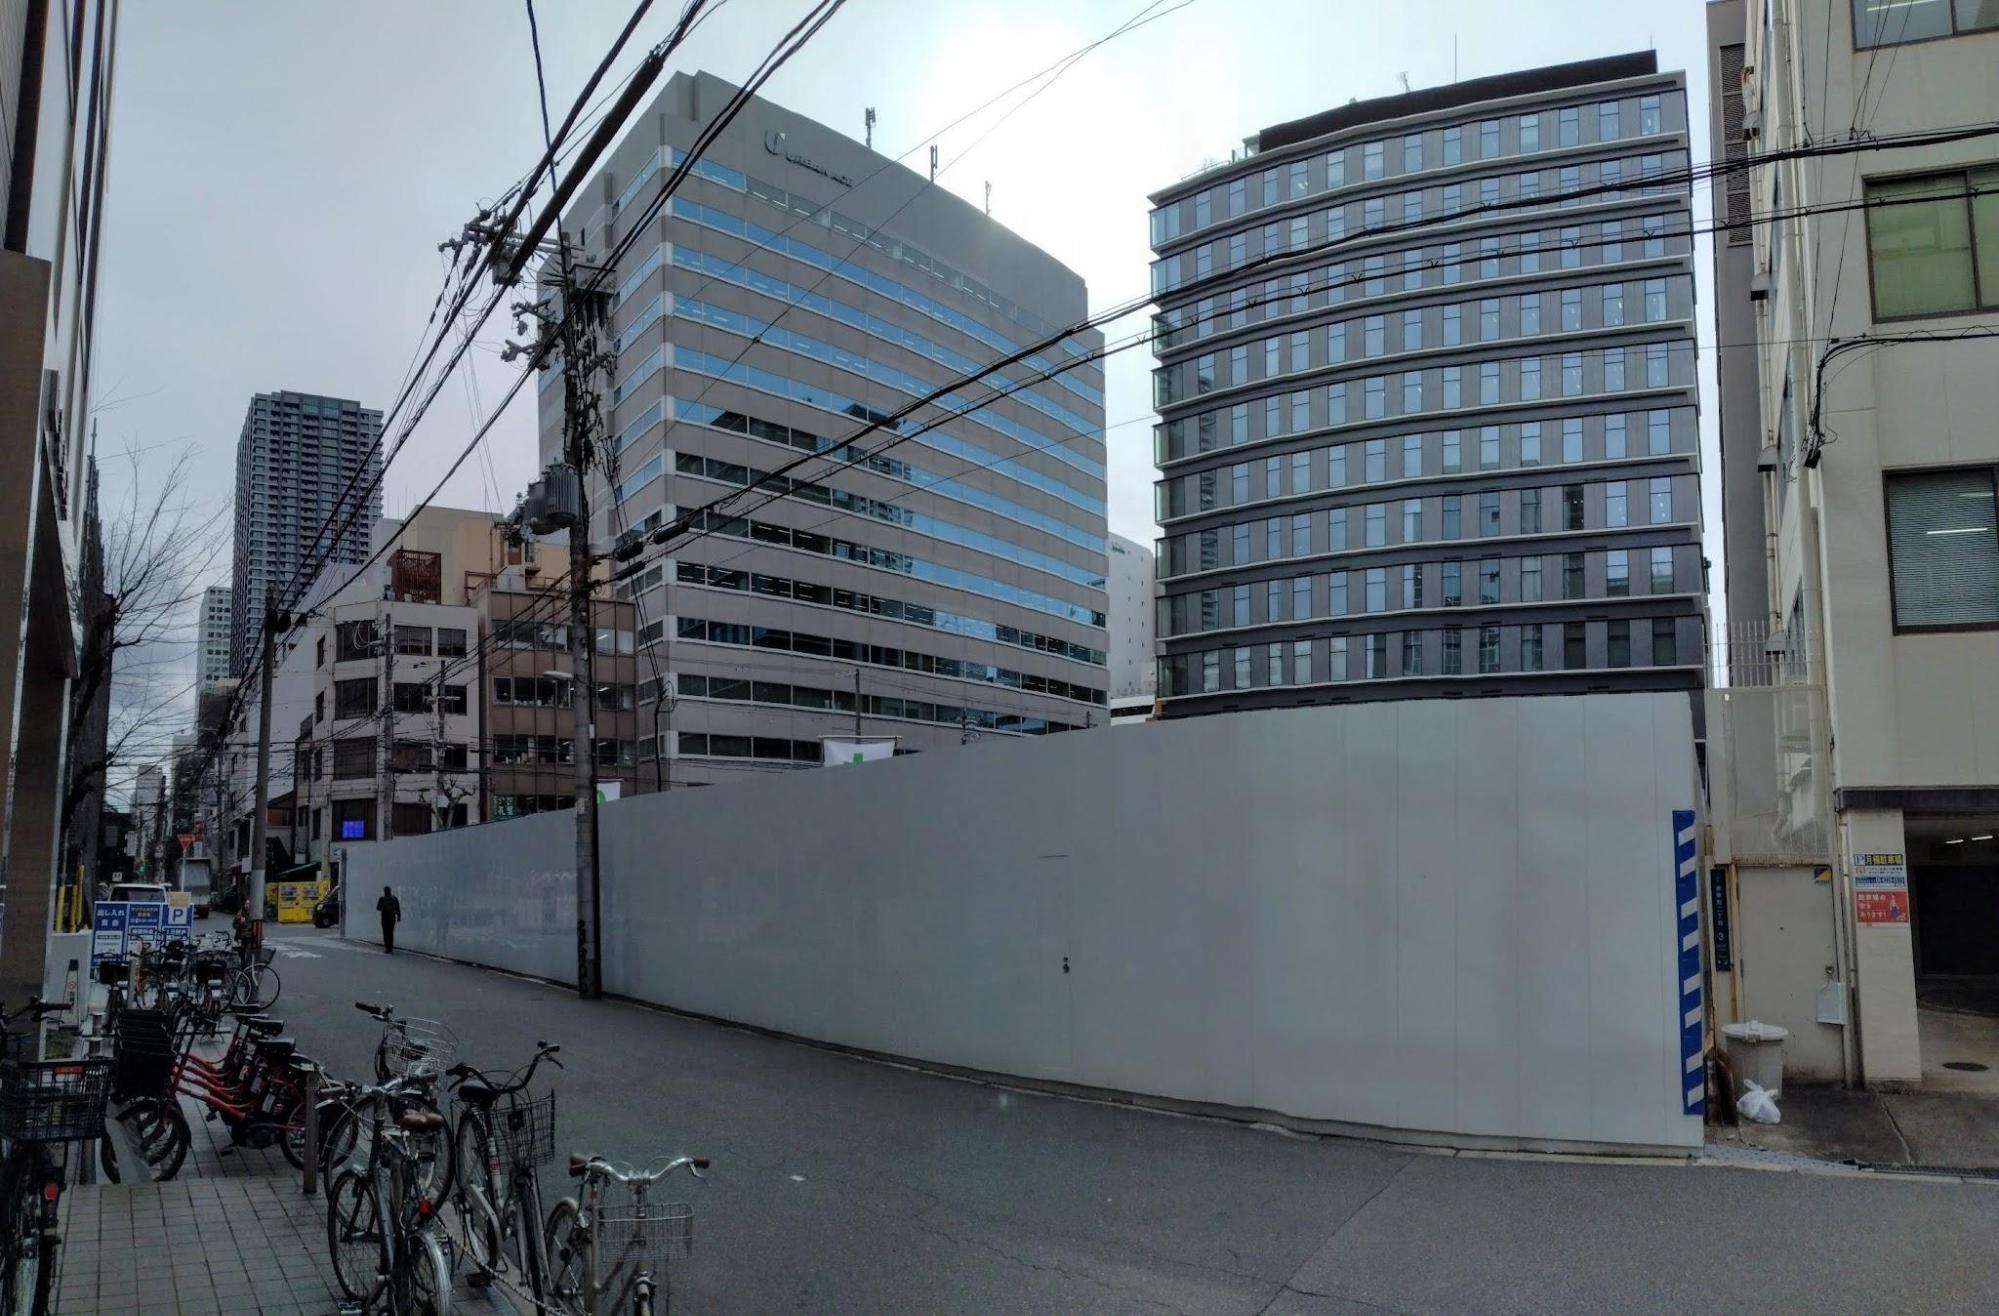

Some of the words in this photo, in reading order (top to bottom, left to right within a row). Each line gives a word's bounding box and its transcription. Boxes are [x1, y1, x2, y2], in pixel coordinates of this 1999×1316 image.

[1856, 855, 1865, 864] P
[97, 909, 125, 917] 出し入れ
[173, 909, 183, 922] P
